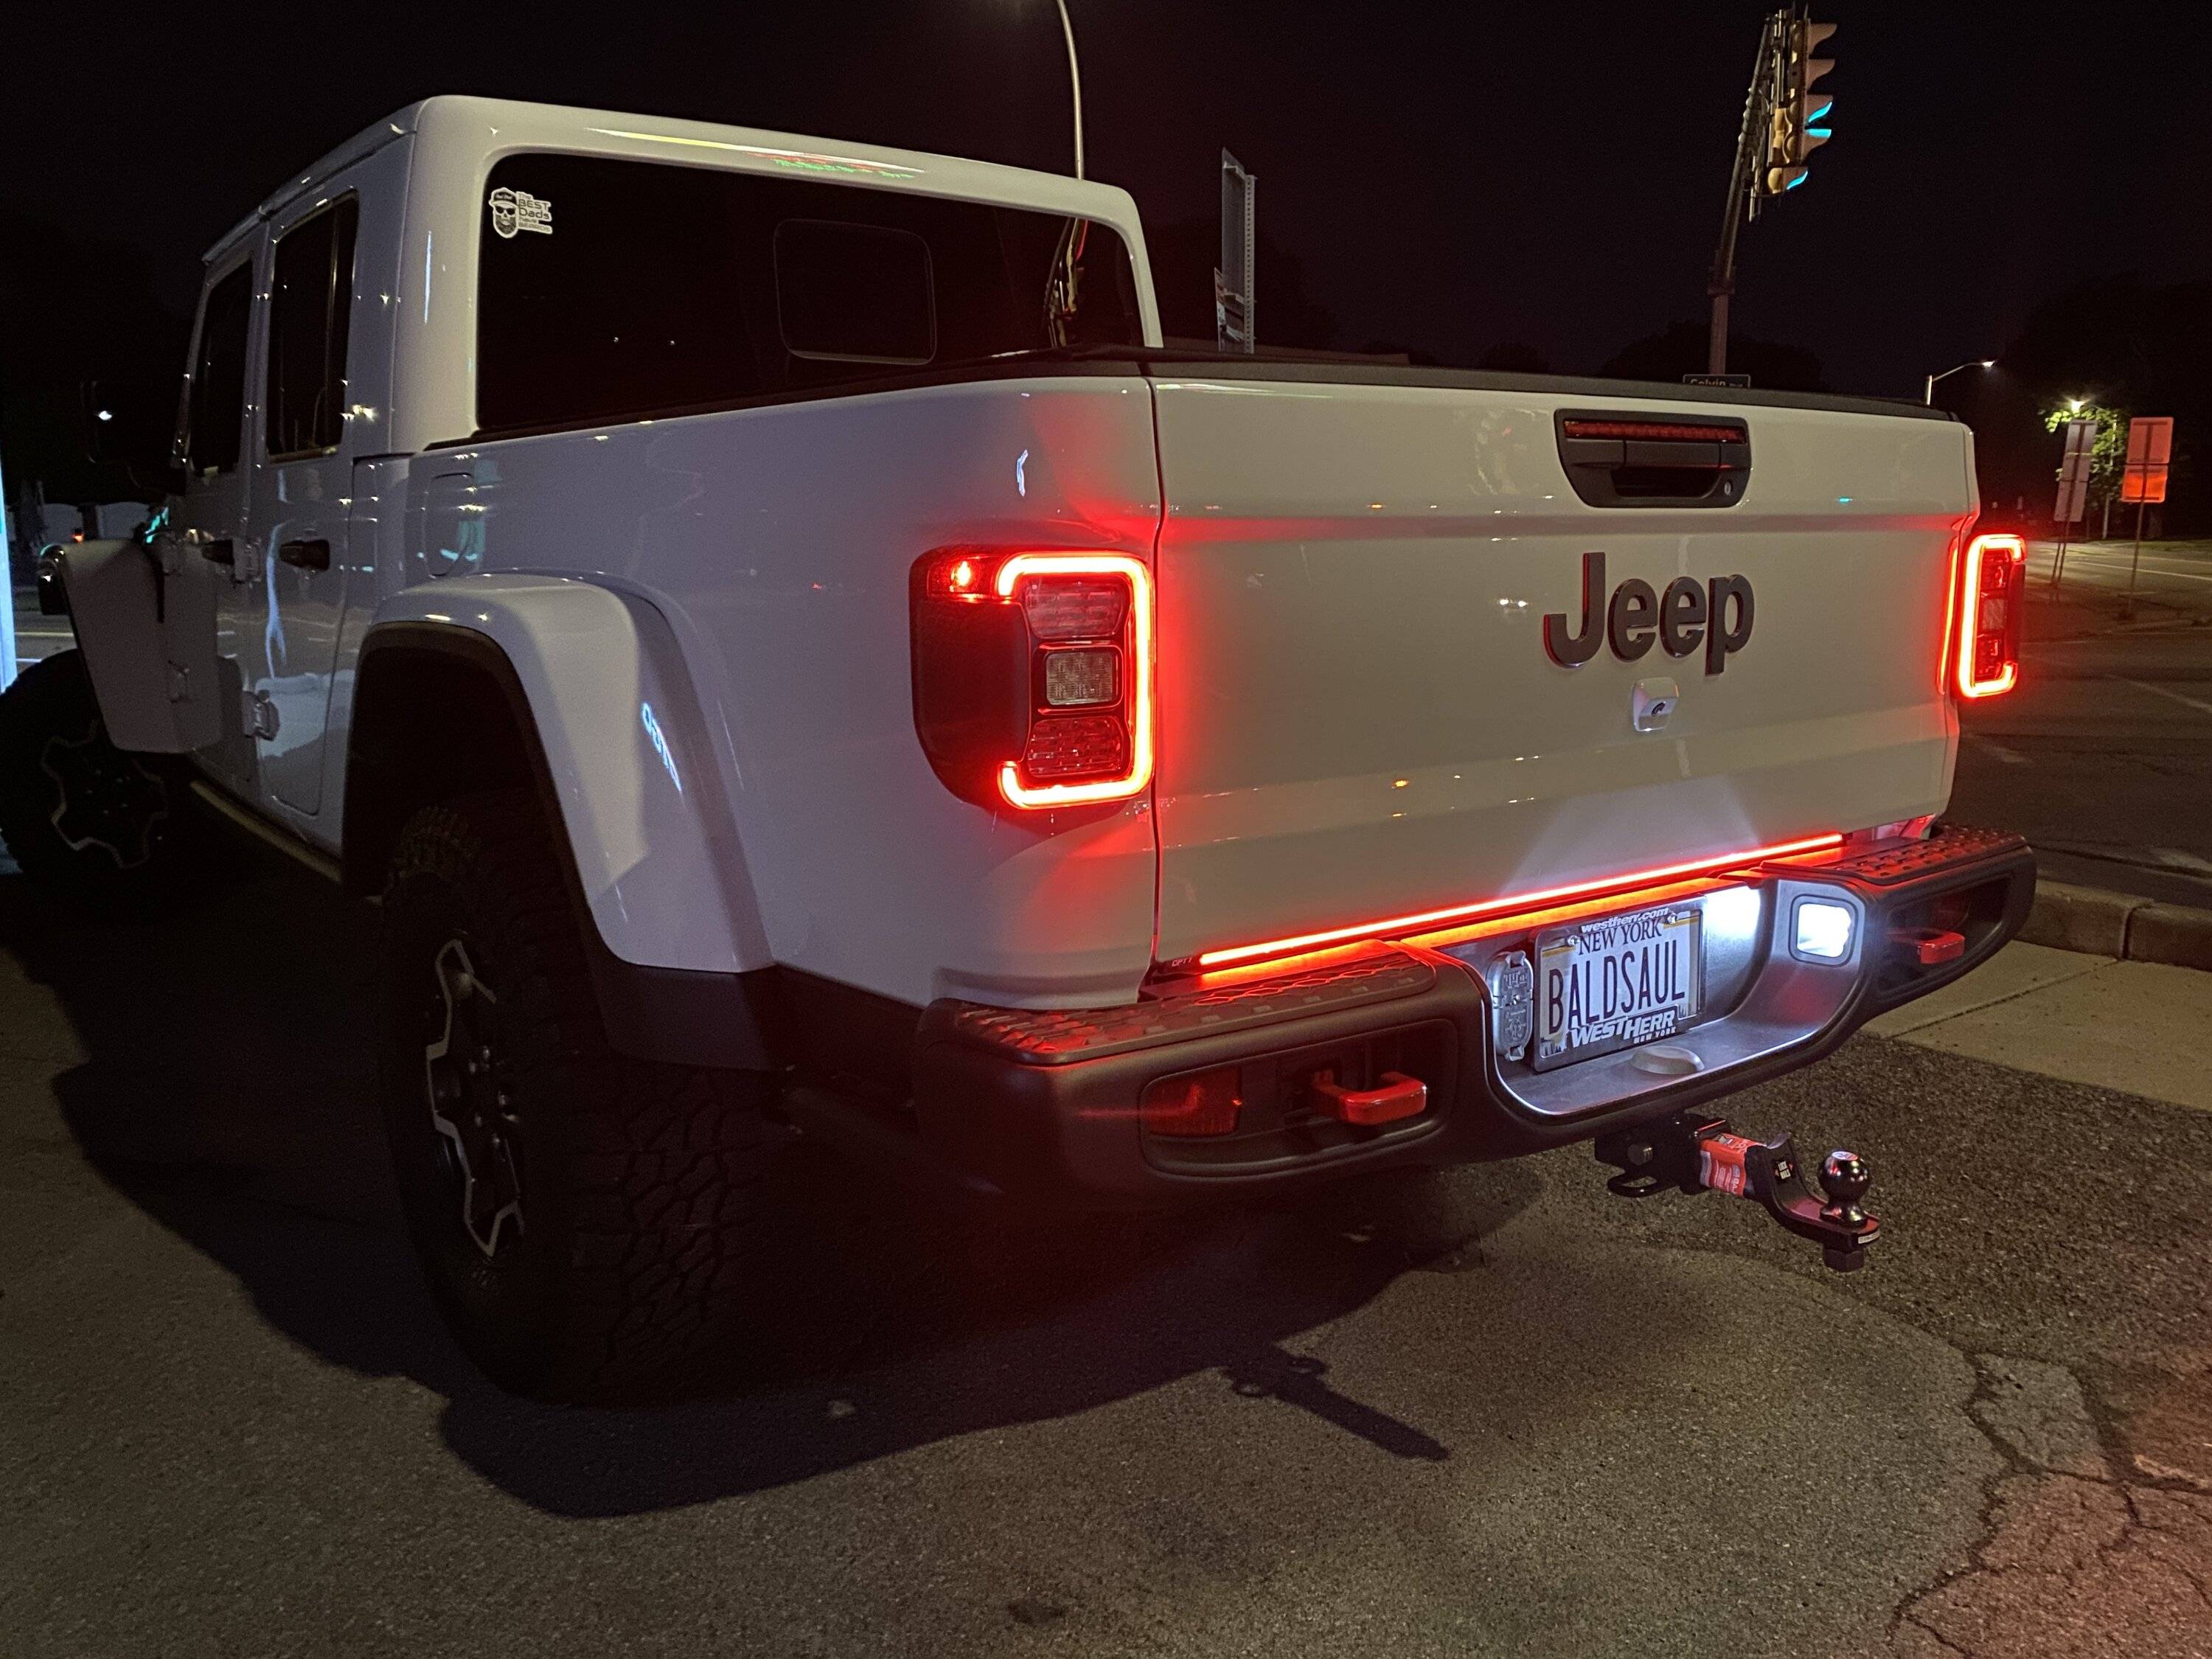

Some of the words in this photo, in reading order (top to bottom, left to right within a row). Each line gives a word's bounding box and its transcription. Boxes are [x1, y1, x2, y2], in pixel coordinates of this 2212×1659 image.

[518, 199, 549, 210] BEST
[518, 207, 550, 220] Dads
[1543, 552, 1755, 677] Jeep
[1579, 927, 1618, 956] NEW
[1621, 918, 1663, 945] YORK
[1548, 939, 1686, 1035] BALDSAUL
[1655, 1026, 1677, 1038] YORK
